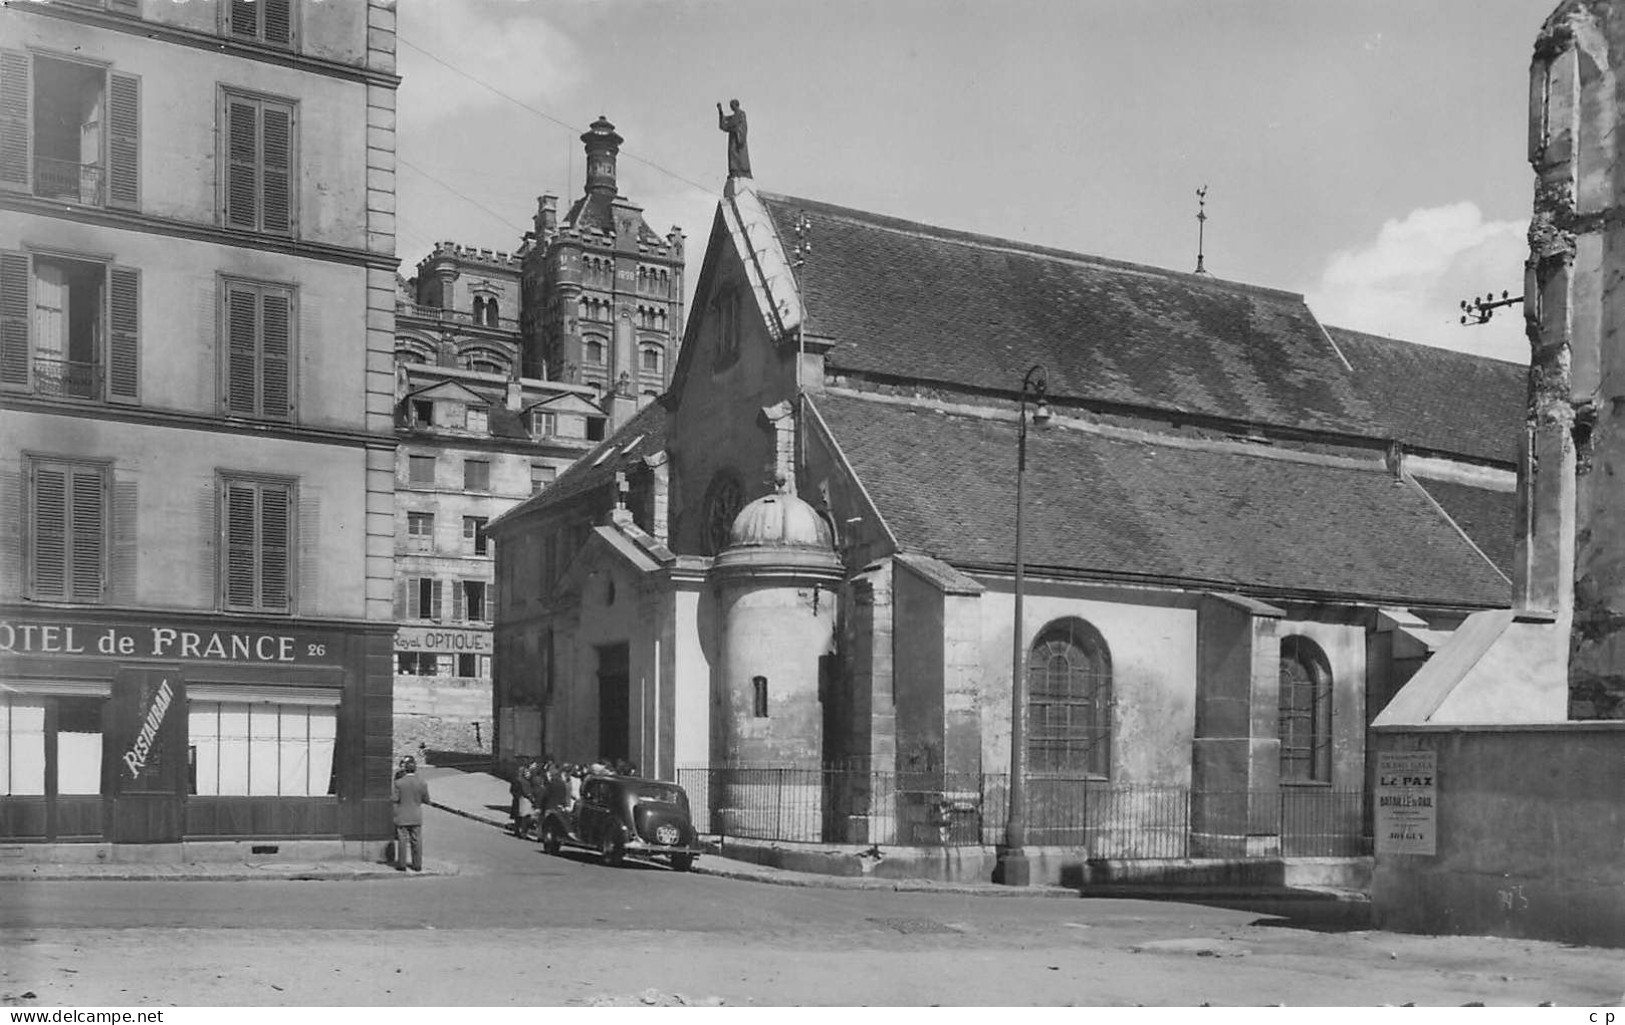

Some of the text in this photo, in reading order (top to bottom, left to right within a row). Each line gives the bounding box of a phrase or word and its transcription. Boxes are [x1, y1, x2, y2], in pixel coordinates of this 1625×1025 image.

[98, 628, 135, 654] de
[151, 628, 295, 661] FRANCE
[307, 643, 326, 657] 26
[425, 633, 483, 650] OPTIQUE
[123, 679, 174, 779] RESTAURANT
